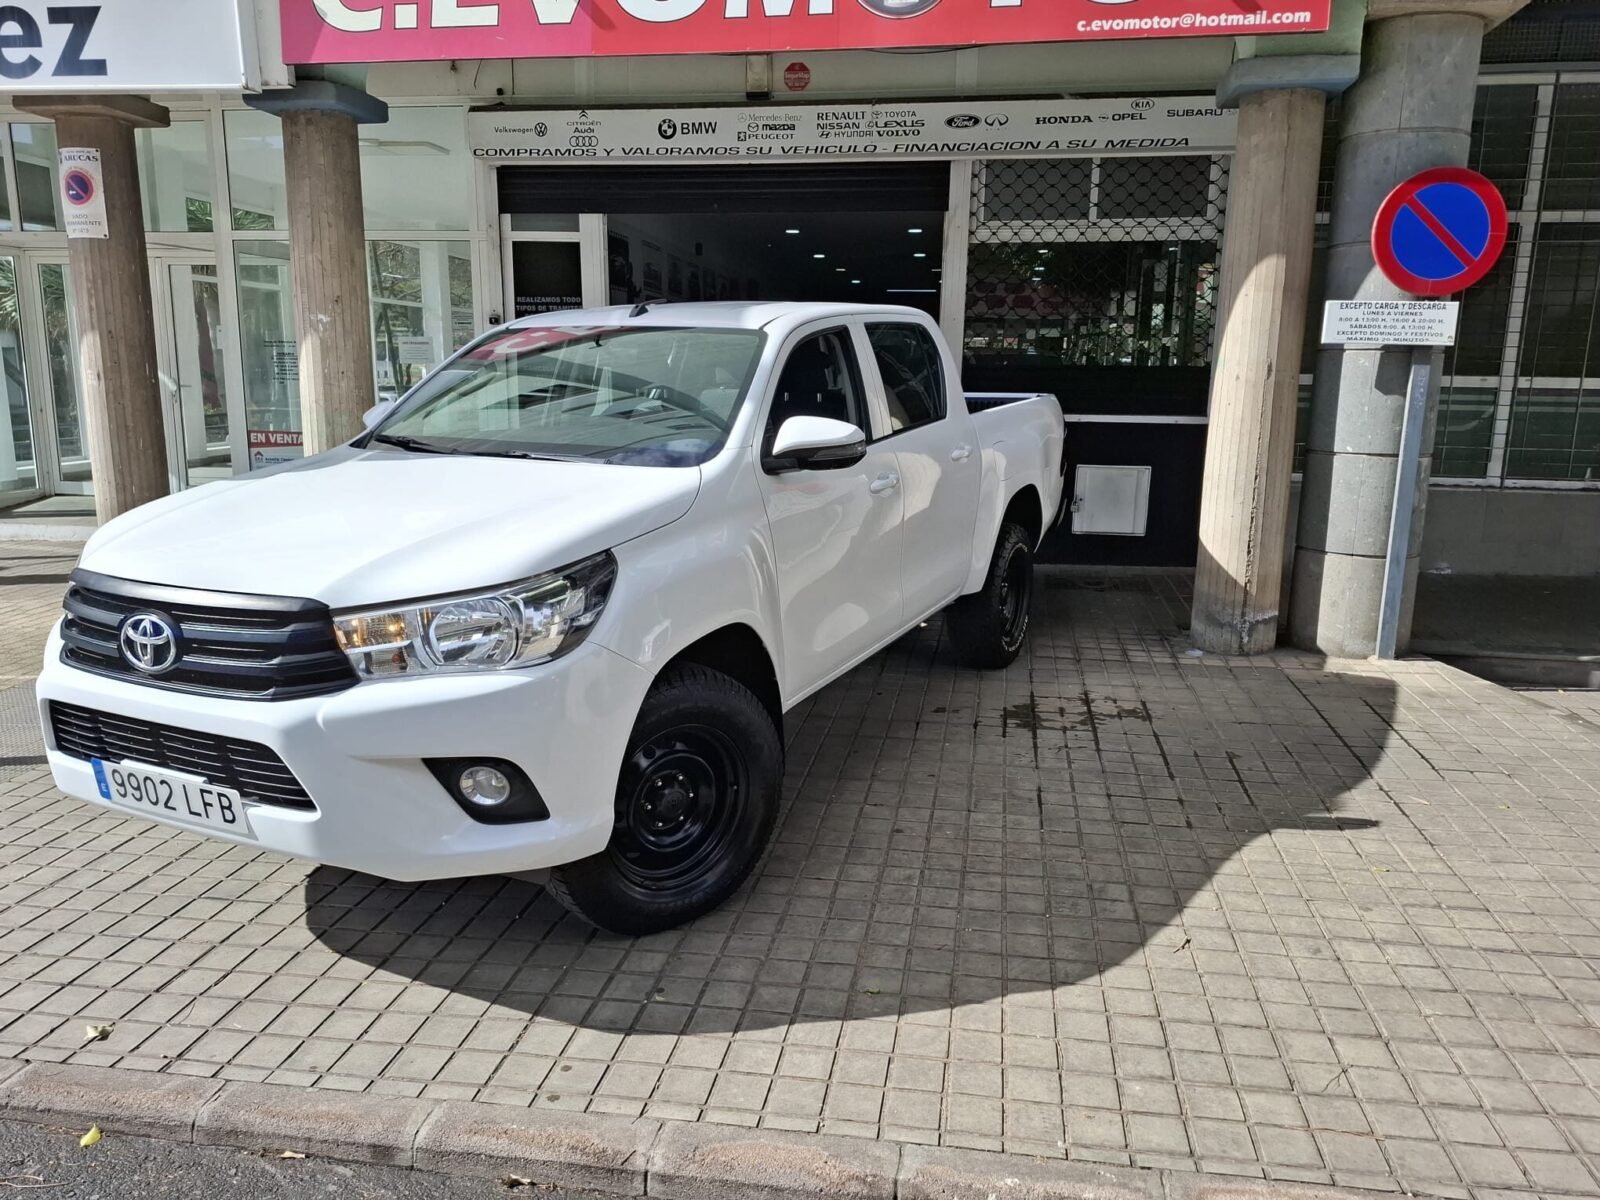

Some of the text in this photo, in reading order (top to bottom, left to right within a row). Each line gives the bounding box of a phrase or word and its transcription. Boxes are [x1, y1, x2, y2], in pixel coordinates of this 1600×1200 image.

[1076, 9, 1312, 32] c.evomotor@hotmail.com
[1134, 100, 1151, 109] KIA
[817, 111, 867, 121] RENAULT
[884, 110, 917, 118] TOYOTA
[1112, 112, 1147, 122] OPEL
[1167, 108, 1223, 118] SUBARU
[875, 119, 925, 128] LEXUS
[950, 115, 975, 128] Ford
[1035, 115, 1093, 125] HONDA
[494, 126, 533, 134] Volkswagen
[681, 121, 718, 135] BMW
[817, 122, 860, 130] NISSAN
[834, 130, 874, 138] HYUNDAI
[876, 129, 921, 137] VOLVO
[473, 148, 597, 157] COMPRAMOS
[600, 148, 614, 157] Y
[621, 146, 740, 156] VALORAMOS
[746, 146, 773, 155] SU
[780, 144, 877, 154] VEHICULO
[893, 140, 1041, 153] FINANCIACION
[1046, 140, 1060, 149] A
[1066, 139, 1097, 149] SU
[1105, 138, 1190, 149] MEDIDA
[64, 154, 98, 162] ARUCAS
[1340, 302, 1373, 310] EXCEPTO
[1375, 302, 1399, 310] CARGA
[1408, 302, 1447, 310] DESCARGA
[250, 433, 303, 444] EN VENTA
[111, 769, 236, 824] 9902 LFB
